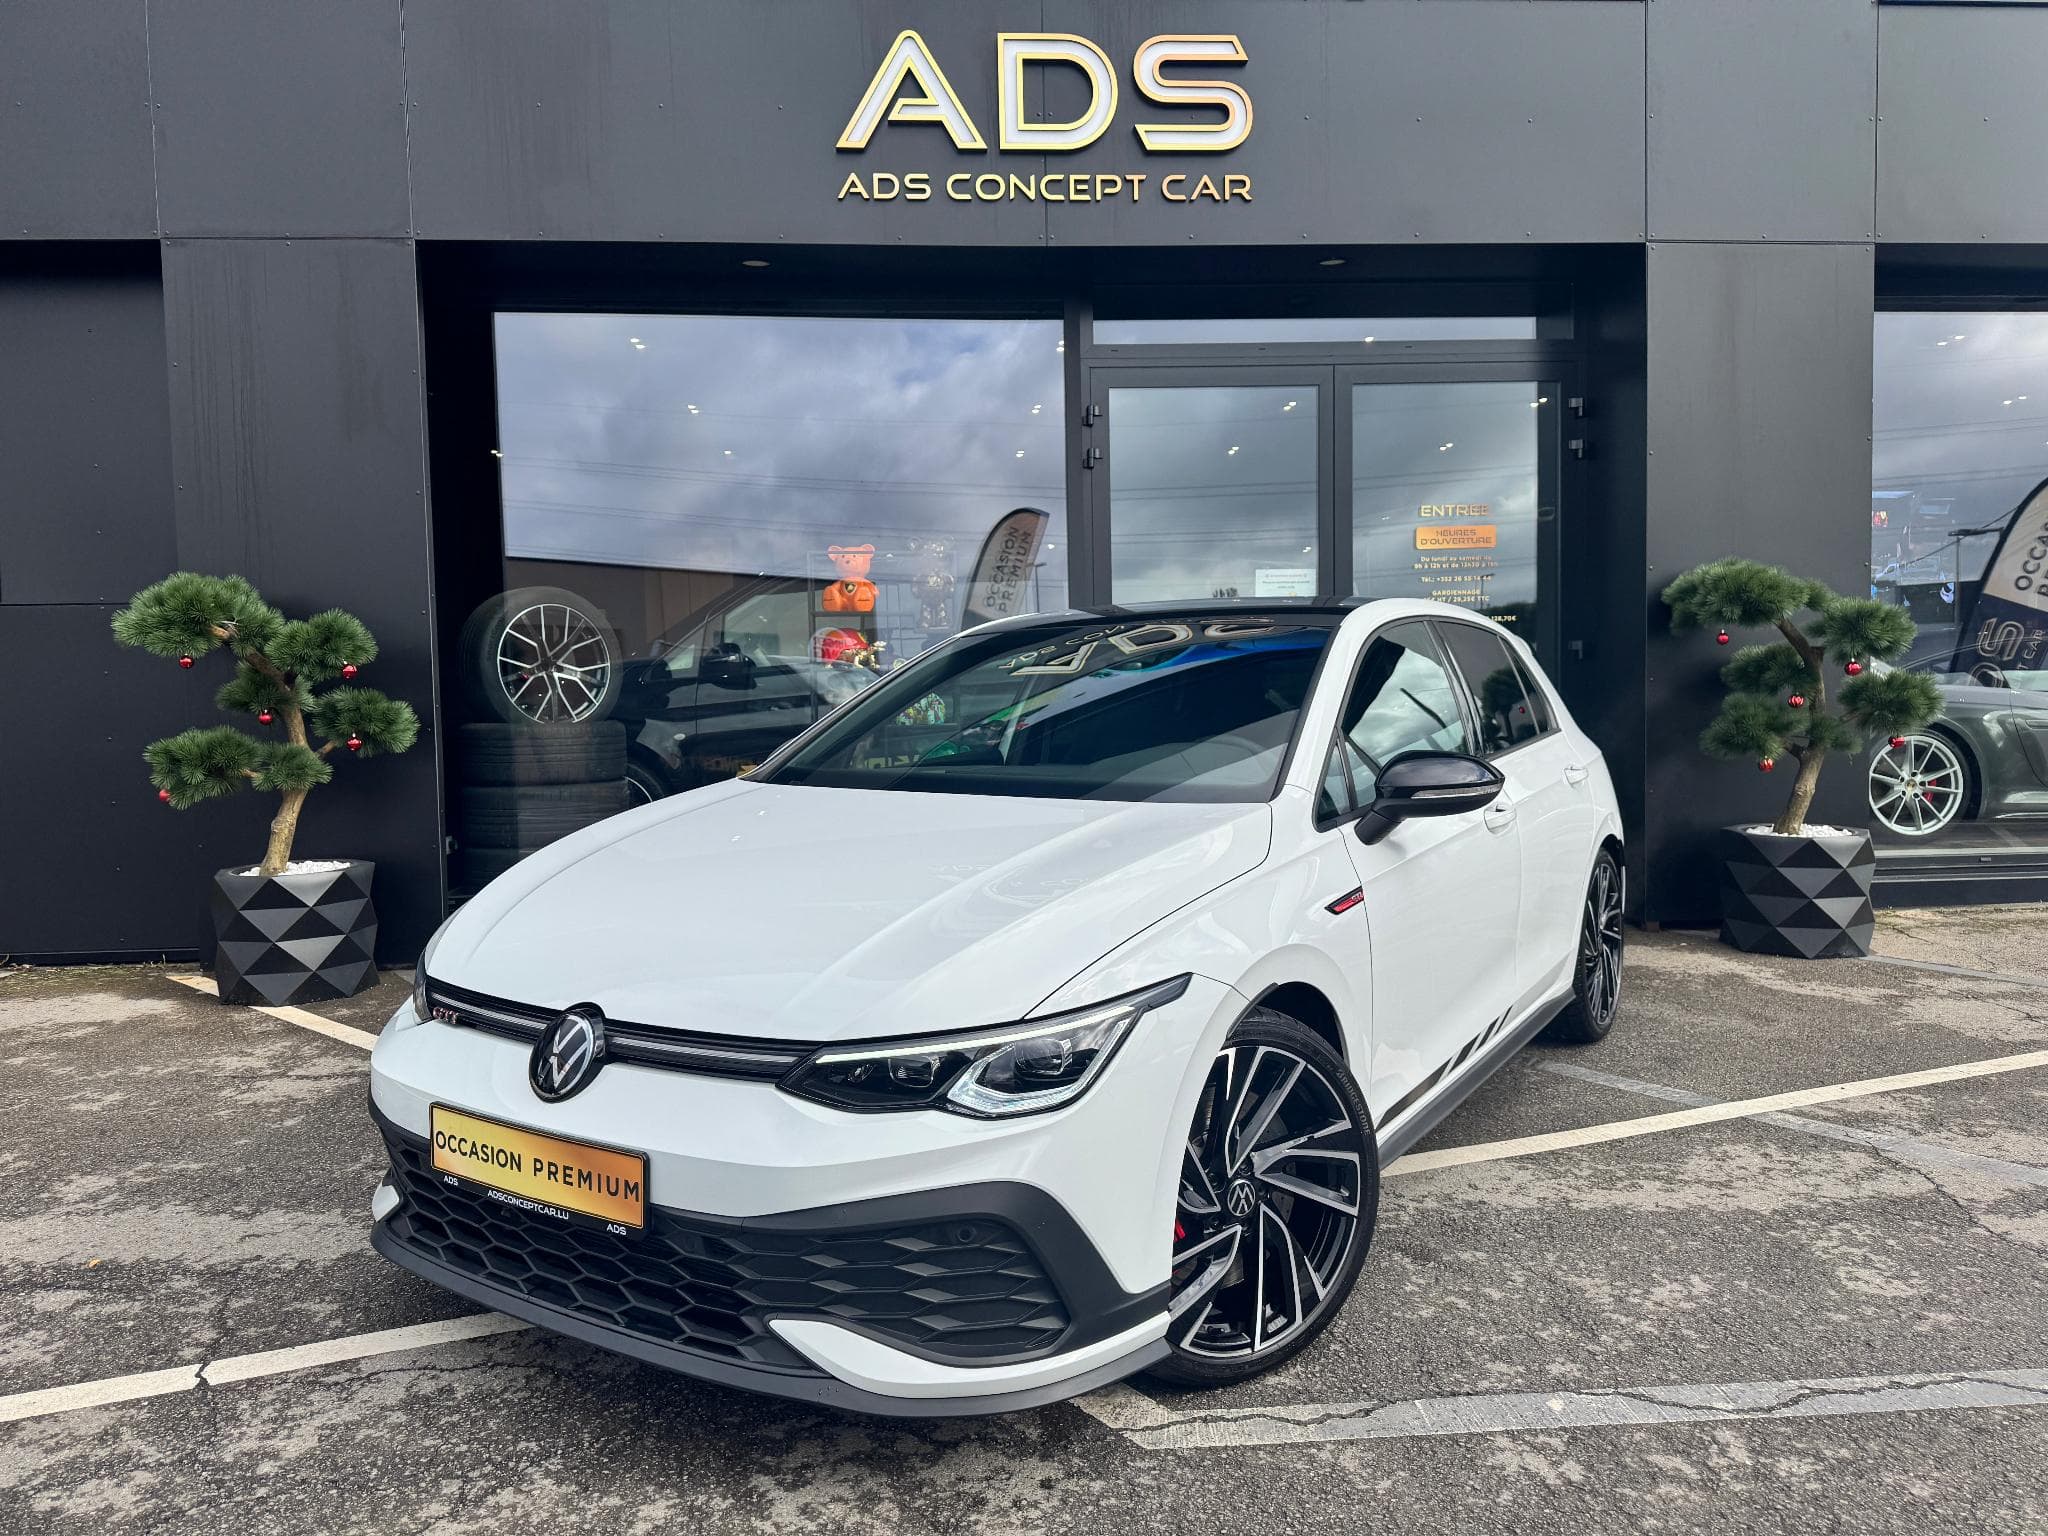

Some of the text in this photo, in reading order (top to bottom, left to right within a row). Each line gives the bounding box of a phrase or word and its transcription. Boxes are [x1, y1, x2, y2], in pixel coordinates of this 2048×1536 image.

[836, 29, 1253, 151] ADS
[838, 172, 1252, 201] ADS CONCEPT CAR
[986, 526, 1019, 608] OCCASION
[999, 530, 1032, 613] PREMIUM
[1336, 1069, 1371, 1136] BRIDGESTONE
[435, 1130, 640, 1202] OCCASION PREMIUM
[443, 1175, 459, 1186] ADS
[487, 1189, 569, 1220] ADSCONCEPTCAR.LU
[606, 1223, 627, 1236] ADS
